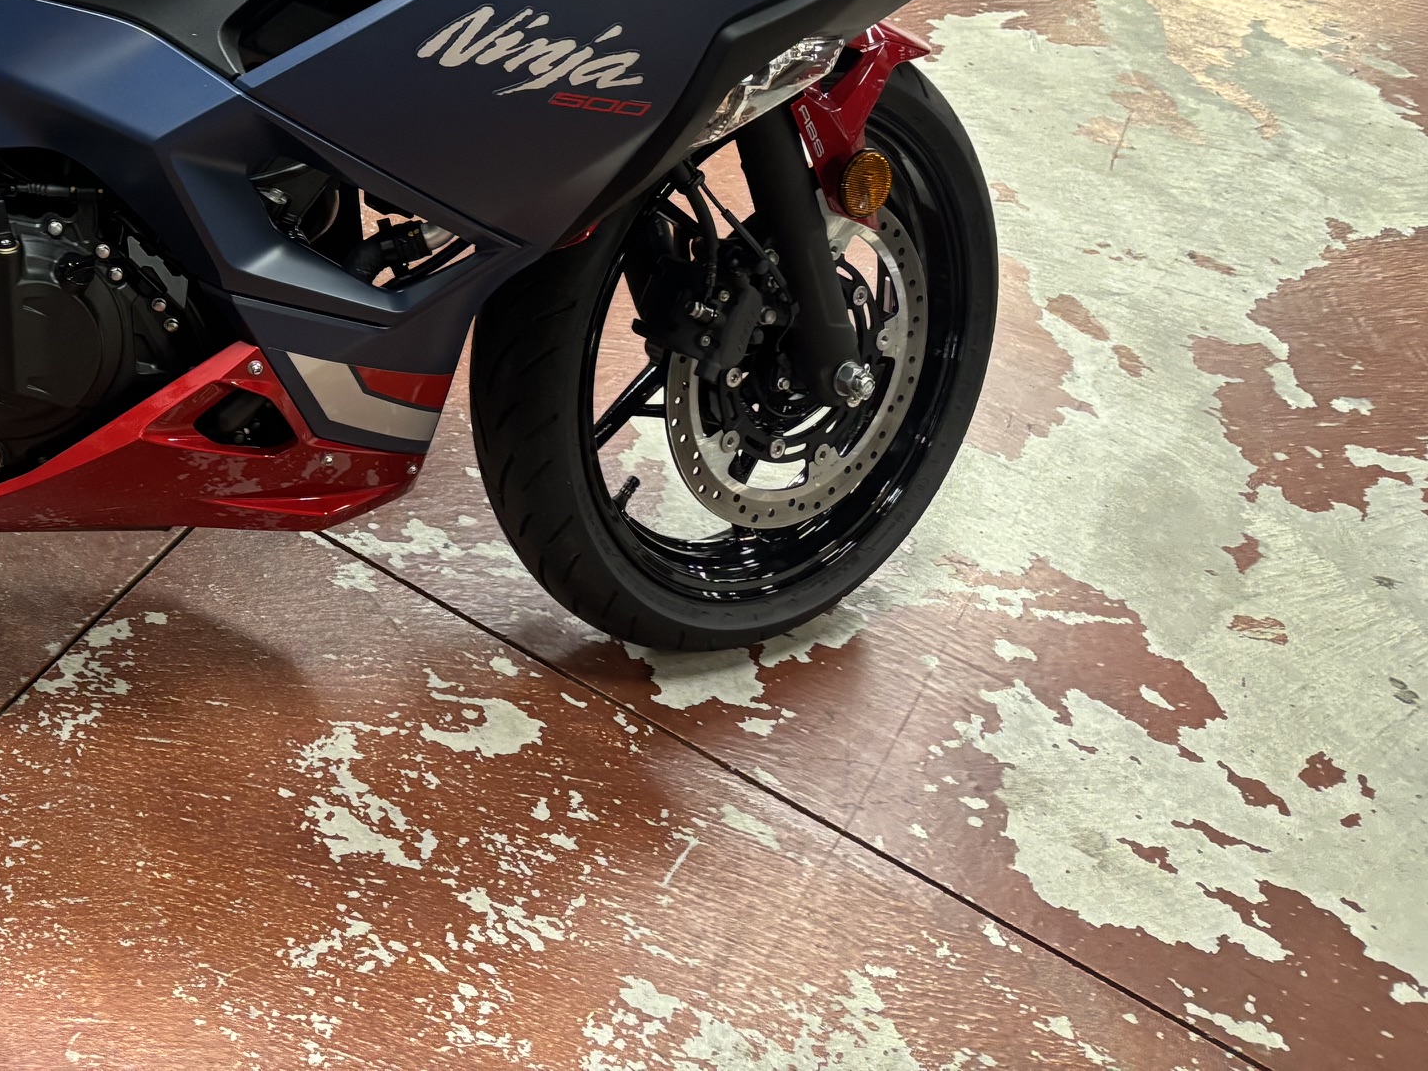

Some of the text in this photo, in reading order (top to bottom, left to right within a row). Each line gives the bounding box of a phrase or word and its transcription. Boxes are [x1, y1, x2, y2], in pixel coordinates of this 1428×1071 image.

[417, 6, 643, 96] Ninja
[549, 92, 652, 116] 500
[798, 104, 825, 158] ABS
